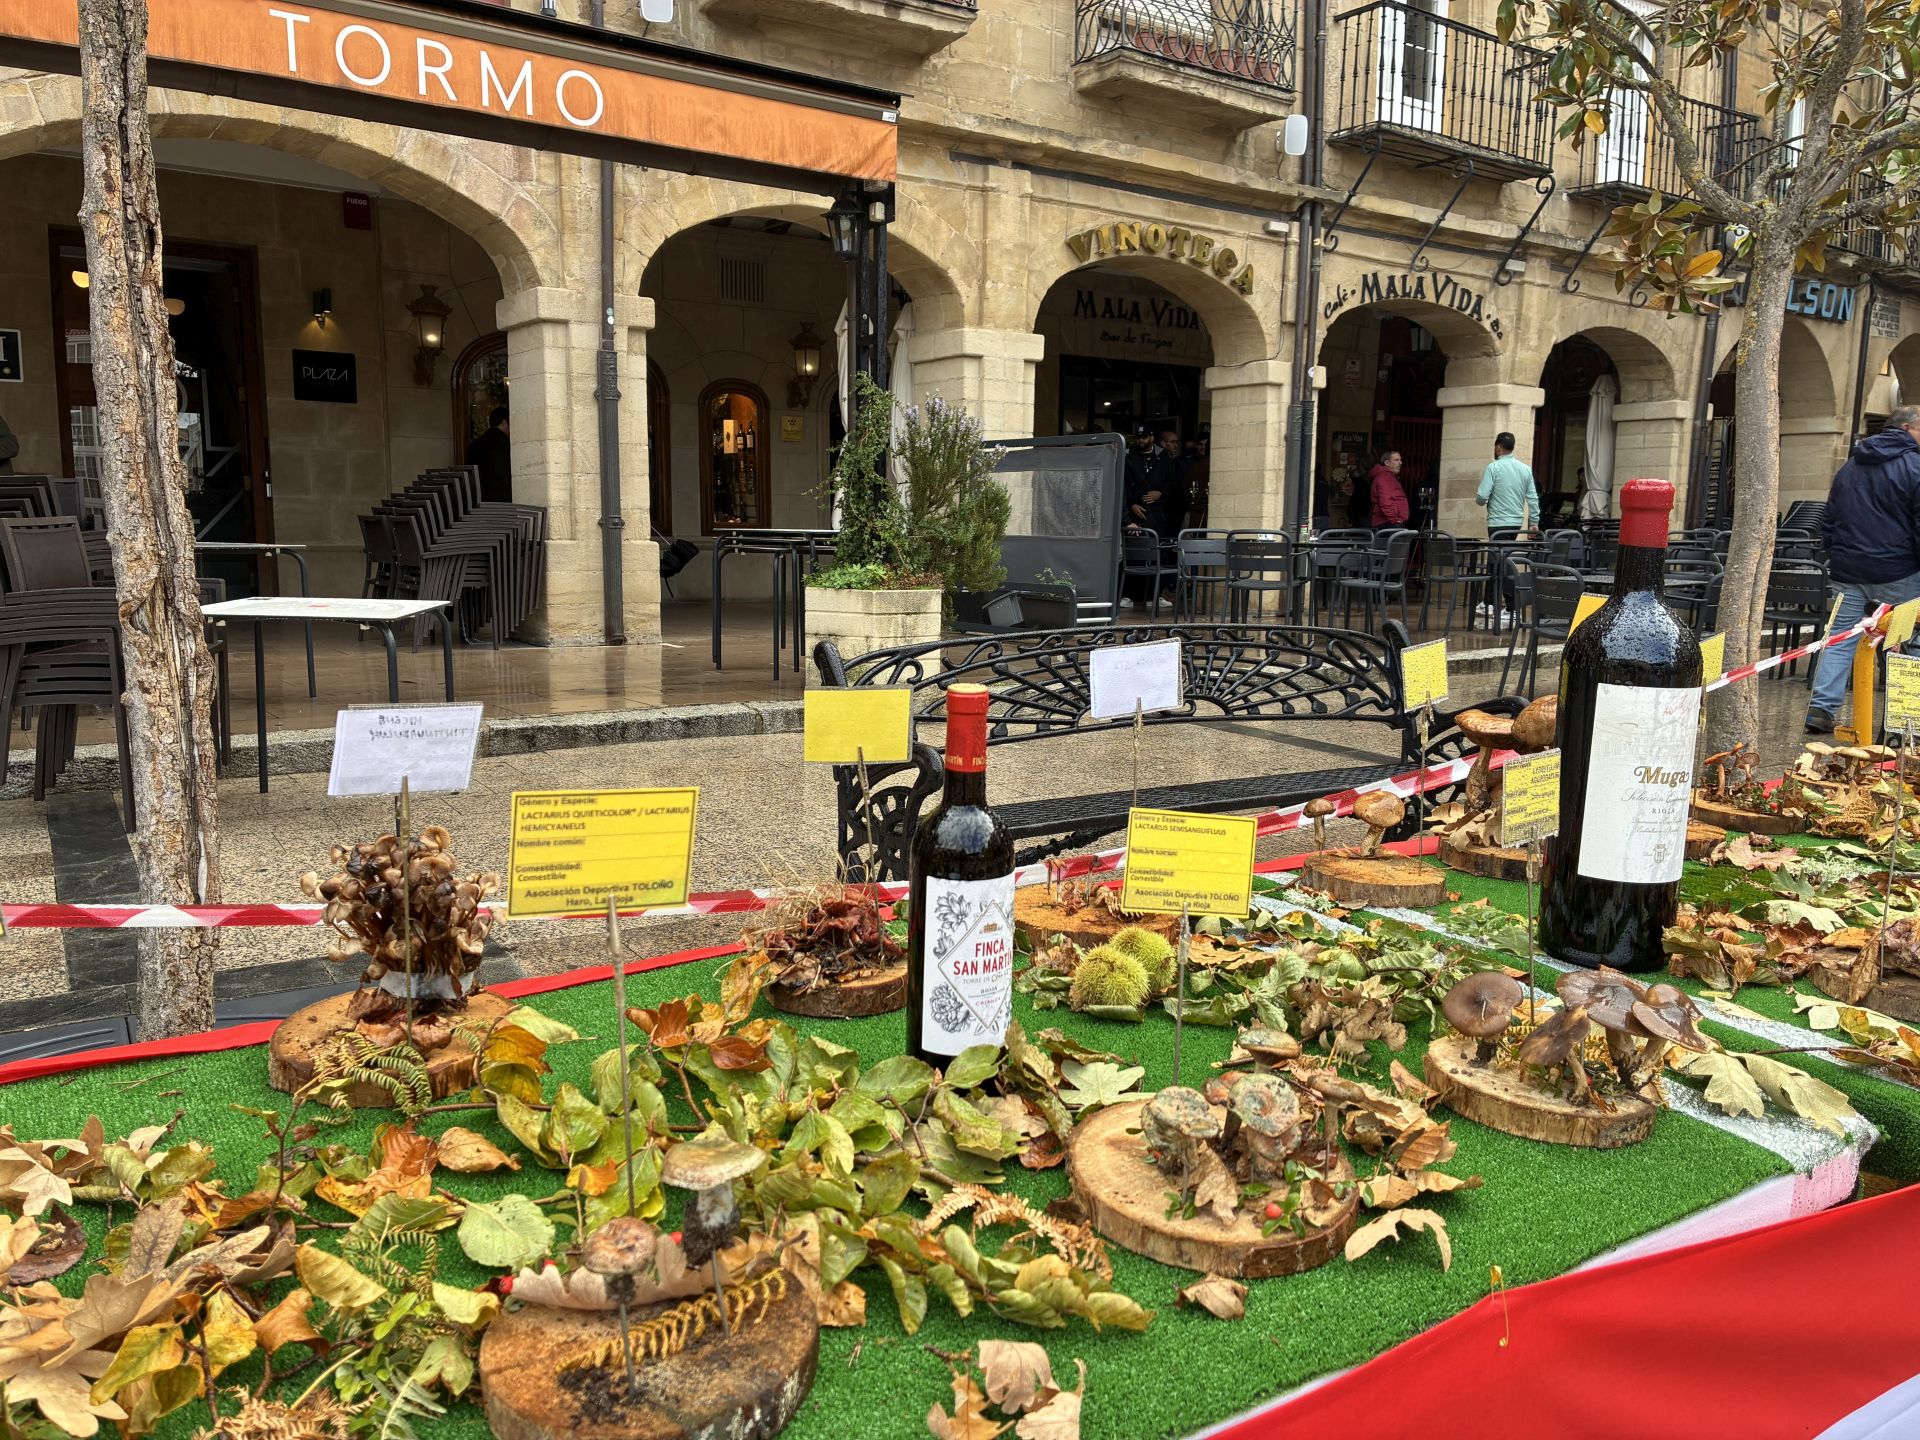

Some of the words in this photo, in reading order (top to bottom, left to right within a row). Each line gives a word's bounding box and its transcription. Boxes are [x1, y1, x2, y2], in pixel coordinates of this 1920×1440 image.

[269, 8, 604, 127] TORMO
[346, 197, 367, 206] FUEGO
[1065, 221, 1254, 296] VINOTECA
[1360, 272, 1427, 303] MALA
[1432, 272, 1485, 322] VIDA
[1786, 279, 1856, 321] LSON
[1073, 289, 1142, 323] MALA
[1151, 298, 1200, 330] VIDA
[302, 366, 348, 382] PLAZA
[1634, 765, 1690, 788] Muga
[519, 797, 552, 806] Género
[553, 799, 559, 807] y
[561, 797, 598, 806] Especie:
[521, 810, 571, 820] LACTARIUS
[644, 806, 690, 816] LACTARIUS
[520, 822, 586, 832] HEMICYANEUS
[1135, 823, 1168, 832] LACTARIUS
[517, 838, 551, 848] Nombre
[553, 837, 586, 846] común:
[1131, 847, 1154, 855] Nombre
[515, 863, 582, 873] Comestibilidad:
[517, 872, 567, 882] Comestible
[524, 886, 581, 898] Asociación
[583, 884, 629, 895] Deportiva
[632, 880, 674, 890] TOLOÑO
[1135, 888, 1173, 898] Asociación
[1175, 889, 1207, 900] Deportiva
[1209, 891, 1239, 902] TOLOÑO
[566, 898, 592, 907] Haro,
[609, 895, 634, 904] ioja
[1163, 899, 1181, 908] Haro,
[1193, 901, 1211, 910] Rioja
[975, 938, 1005, 958] FINCA
[953, 960, 979, 976] SAN
